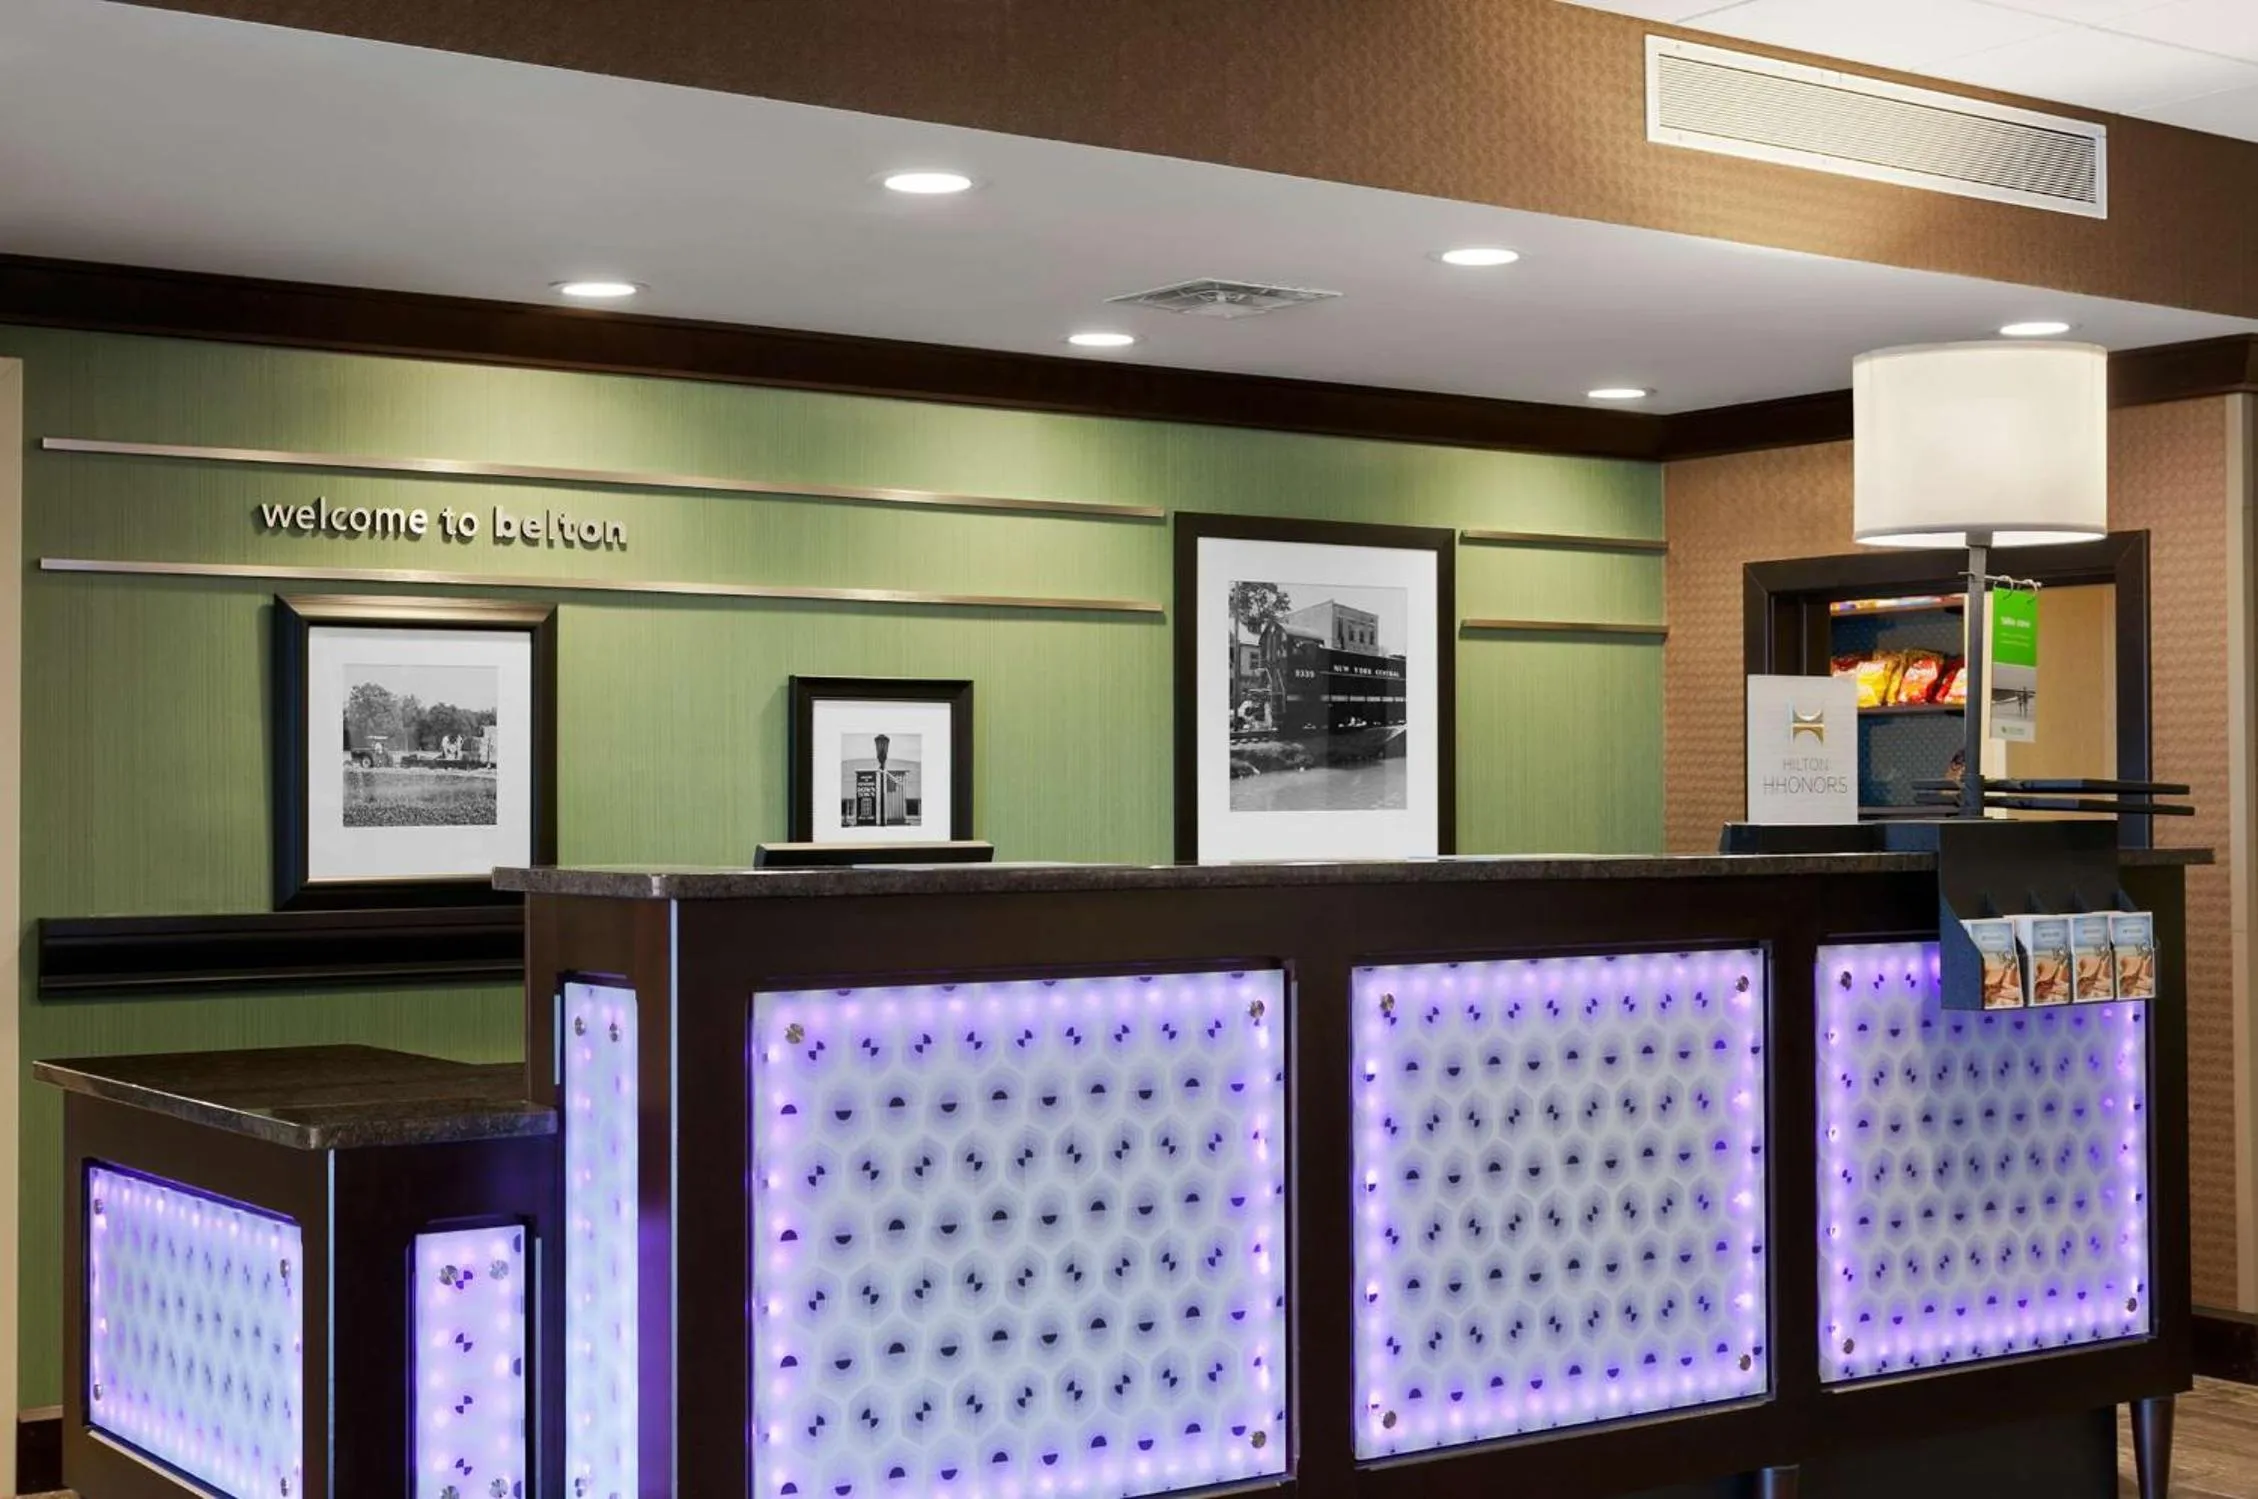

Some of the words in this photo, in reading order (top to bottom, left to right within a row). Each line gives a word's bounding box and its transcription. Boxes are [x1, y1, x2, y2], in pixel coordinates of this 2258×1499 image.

[260, 496, 427, 535] welcome
[441, 506, 480, 537] to
[493, 505, 628, 544] belton
[1782, 757, 1829, 772] HILTON
[1763, 775, 1848, 795] HHONORS
